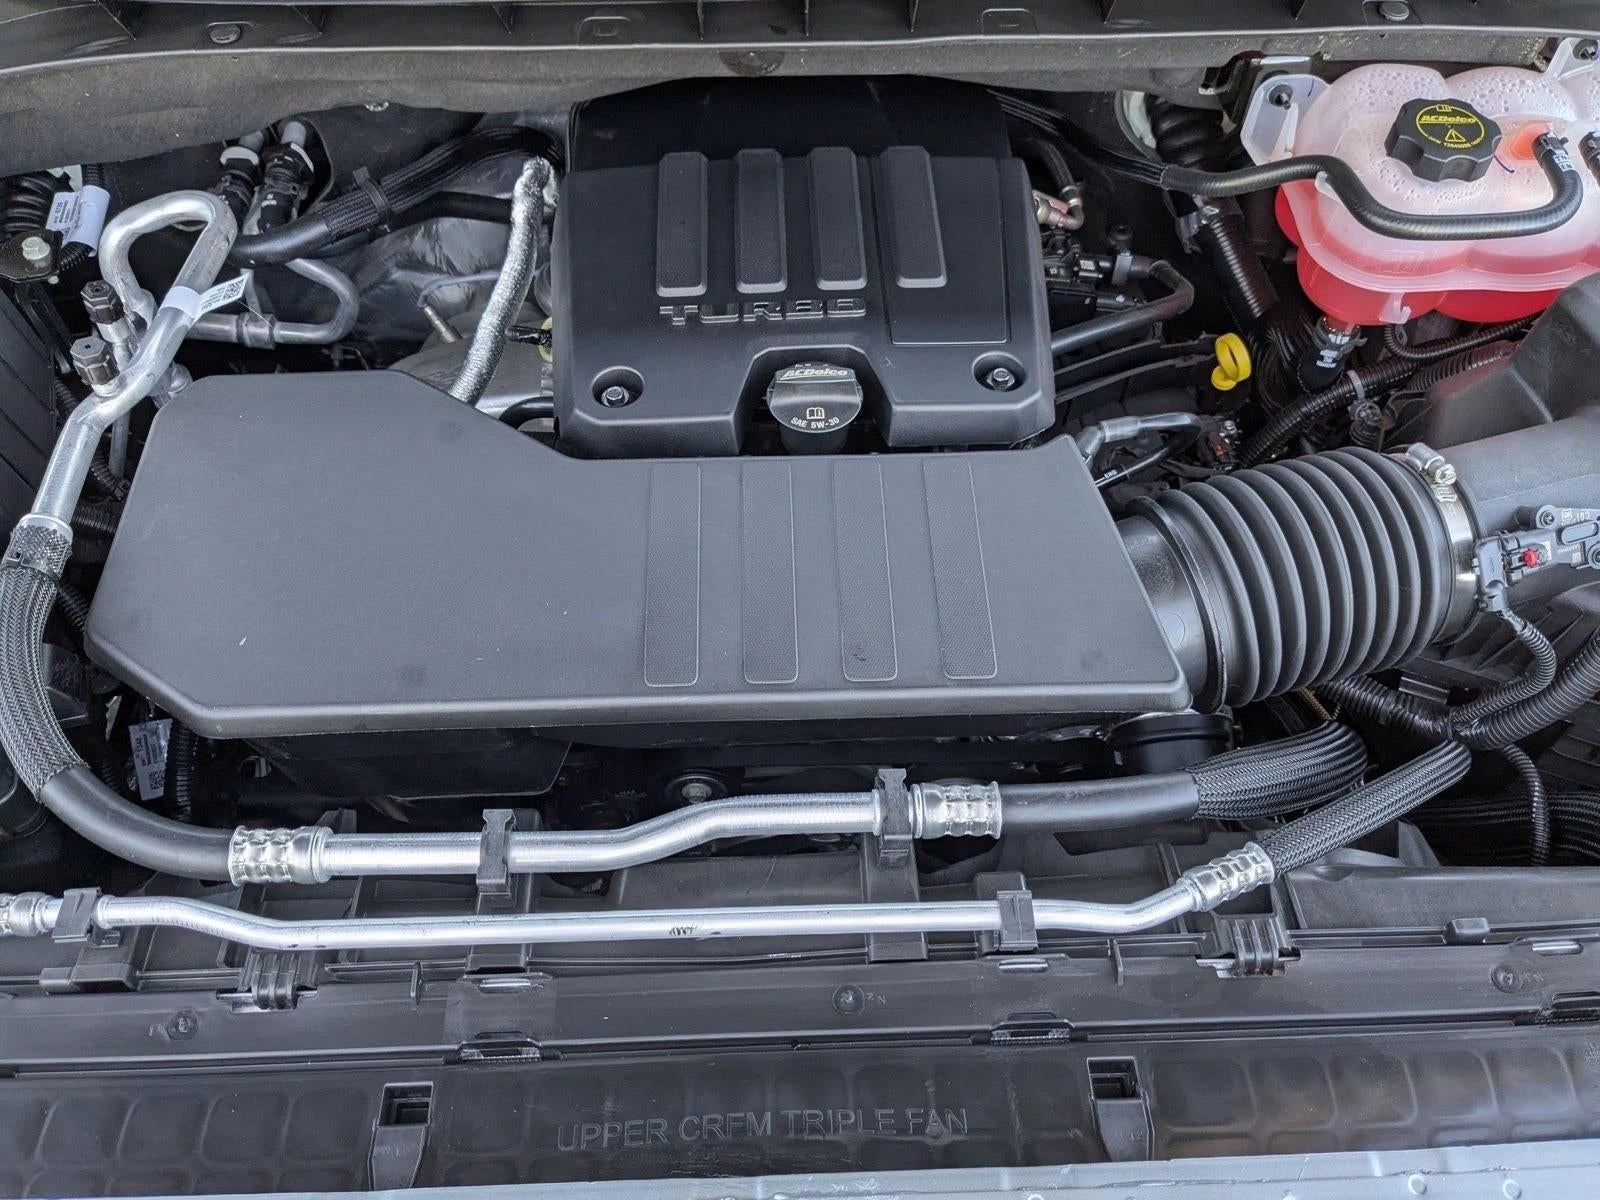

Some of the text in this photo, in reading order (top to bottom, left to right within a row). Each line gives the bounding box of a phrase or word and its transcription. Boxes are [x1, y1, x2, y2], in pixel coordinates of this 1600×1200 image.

[1420, 115, 1477, 124] ACDelco
[659, 299, 867, 325] TURBO
[780, 368, 848, 380] ACDelco
[790, 416, 840, 430] SAE 5W-30
[557, 1108, 968, 1151] UPPER CRFM TRIPLE FAN
